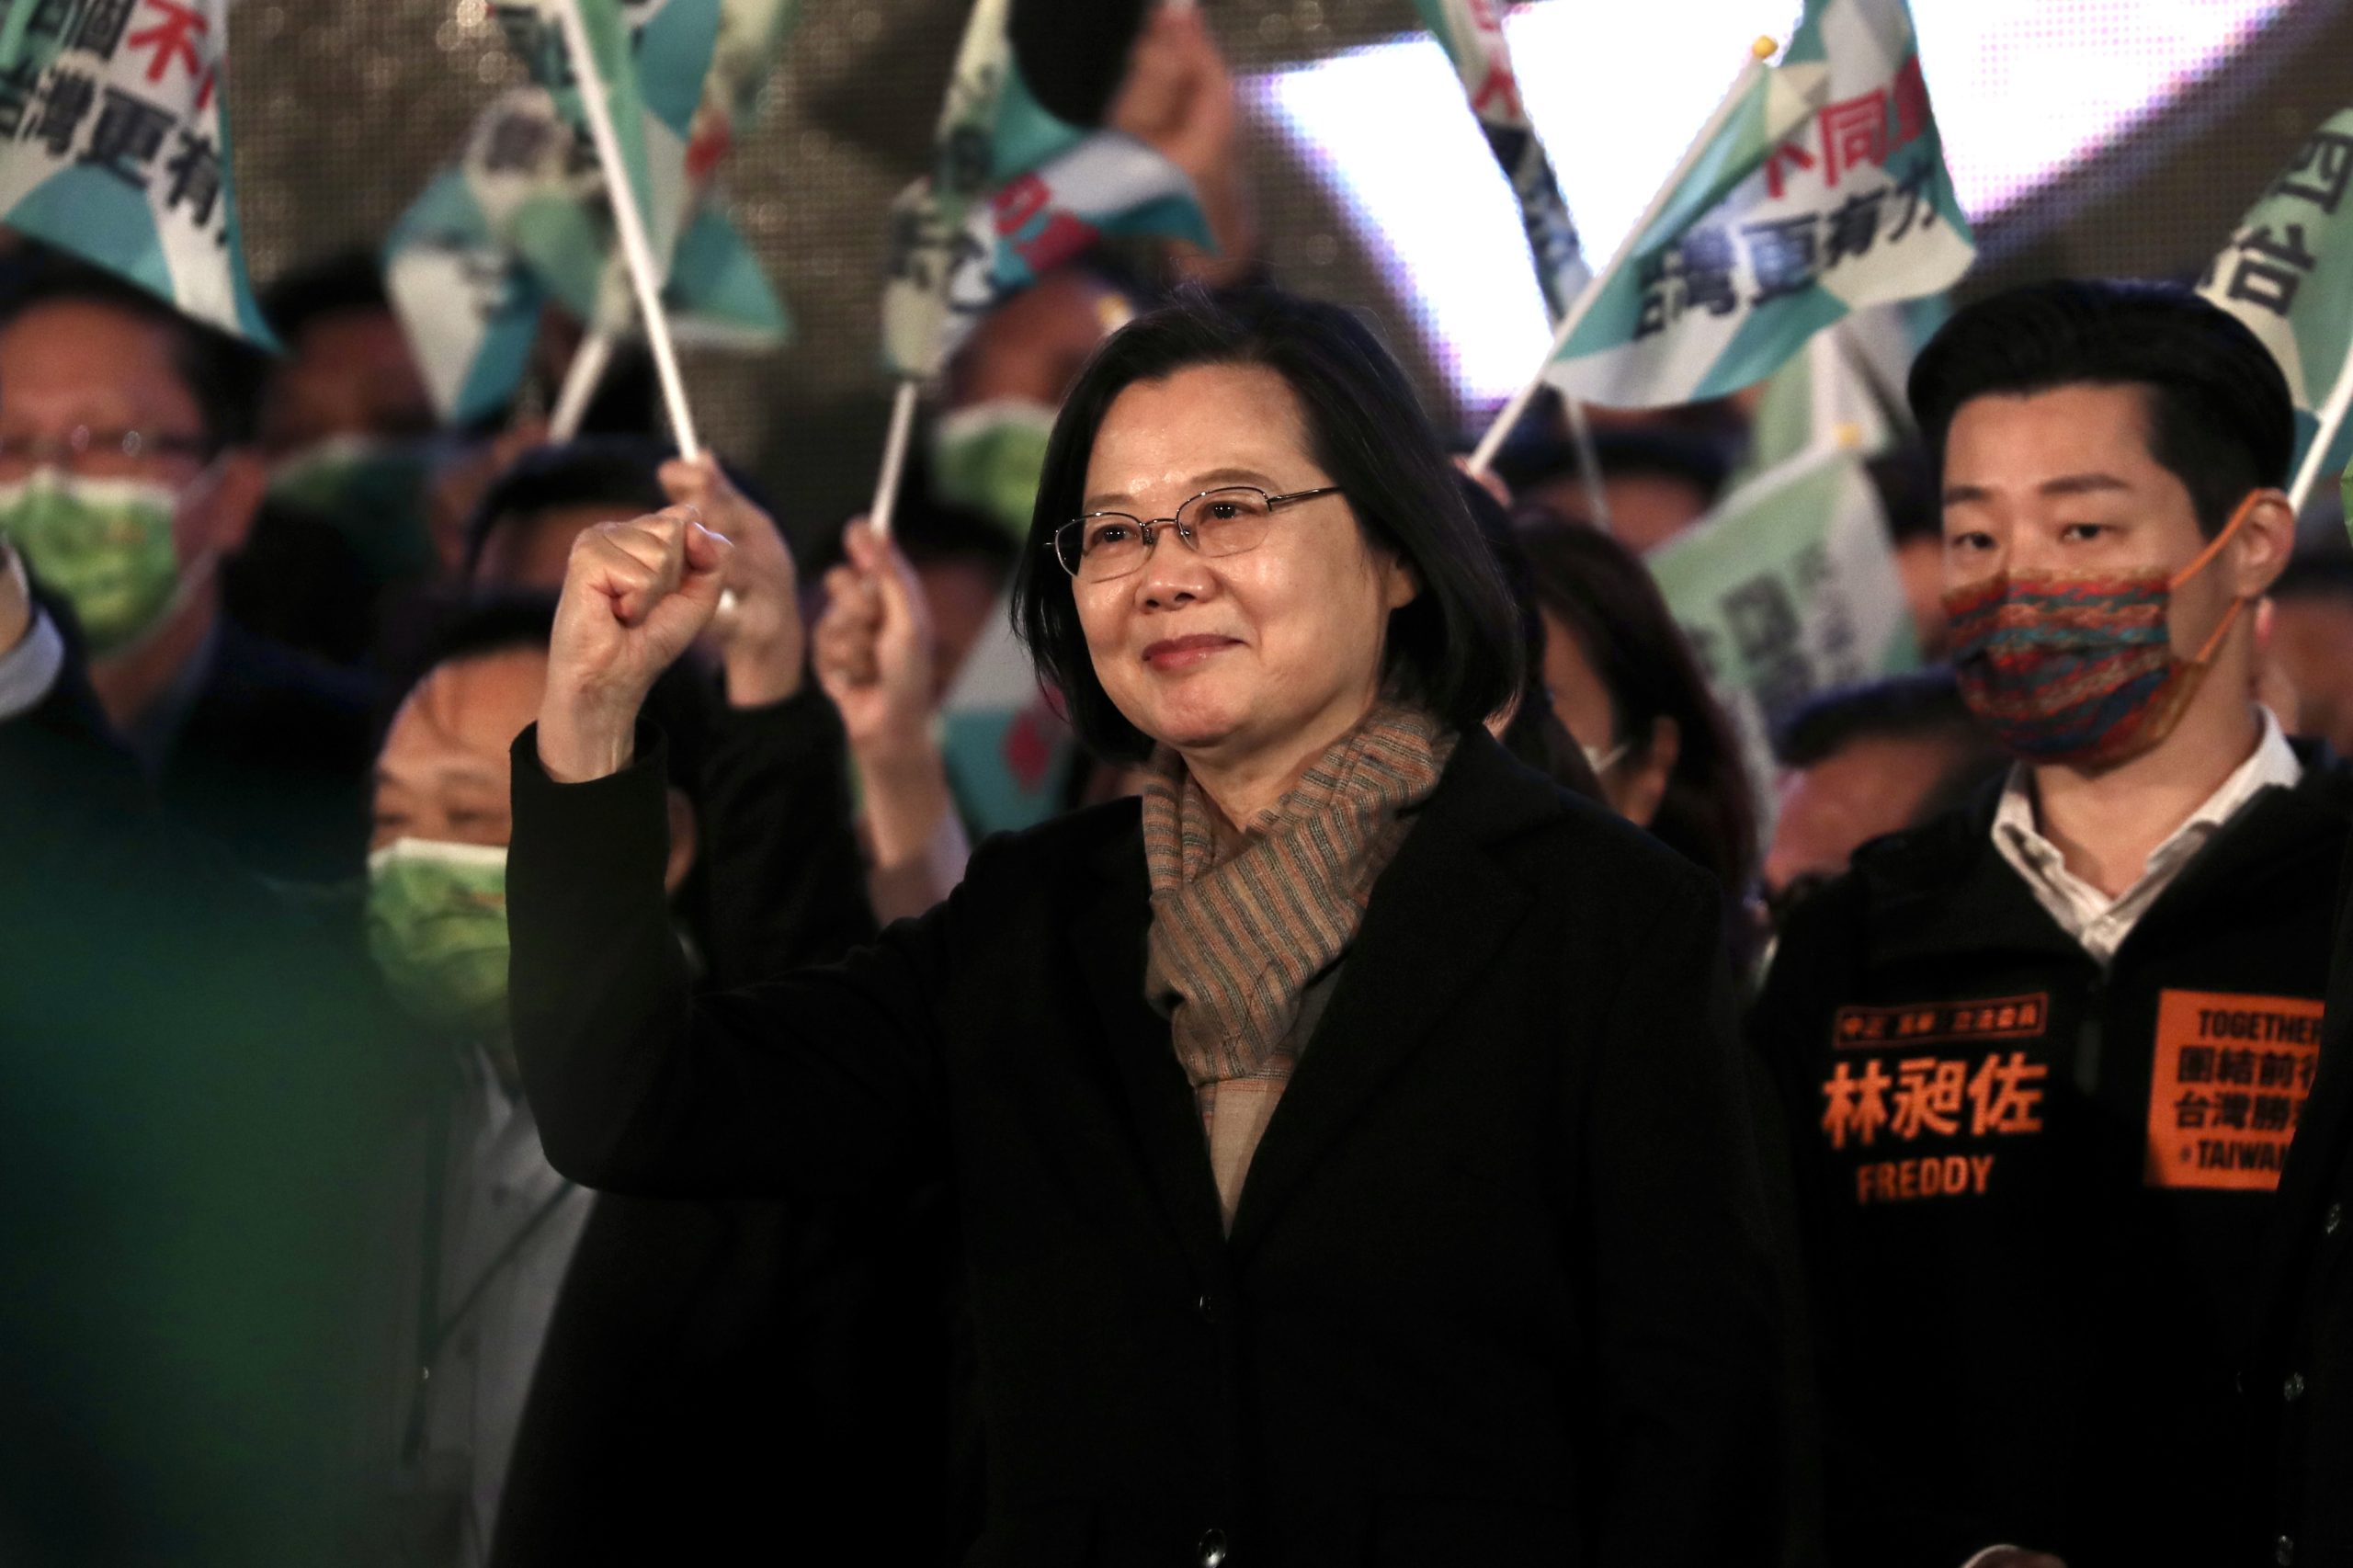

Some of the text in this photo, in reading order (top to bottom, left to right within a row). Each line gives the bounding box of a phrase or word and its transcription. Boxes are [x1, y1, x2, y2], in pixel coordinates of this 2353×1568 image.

[1822, 1052, 2048, 1149] 林昶佐
[2174, 1090, 2303, 1131] 台灣勝
[1858, 1155, 1994, 1203] FREDDY
